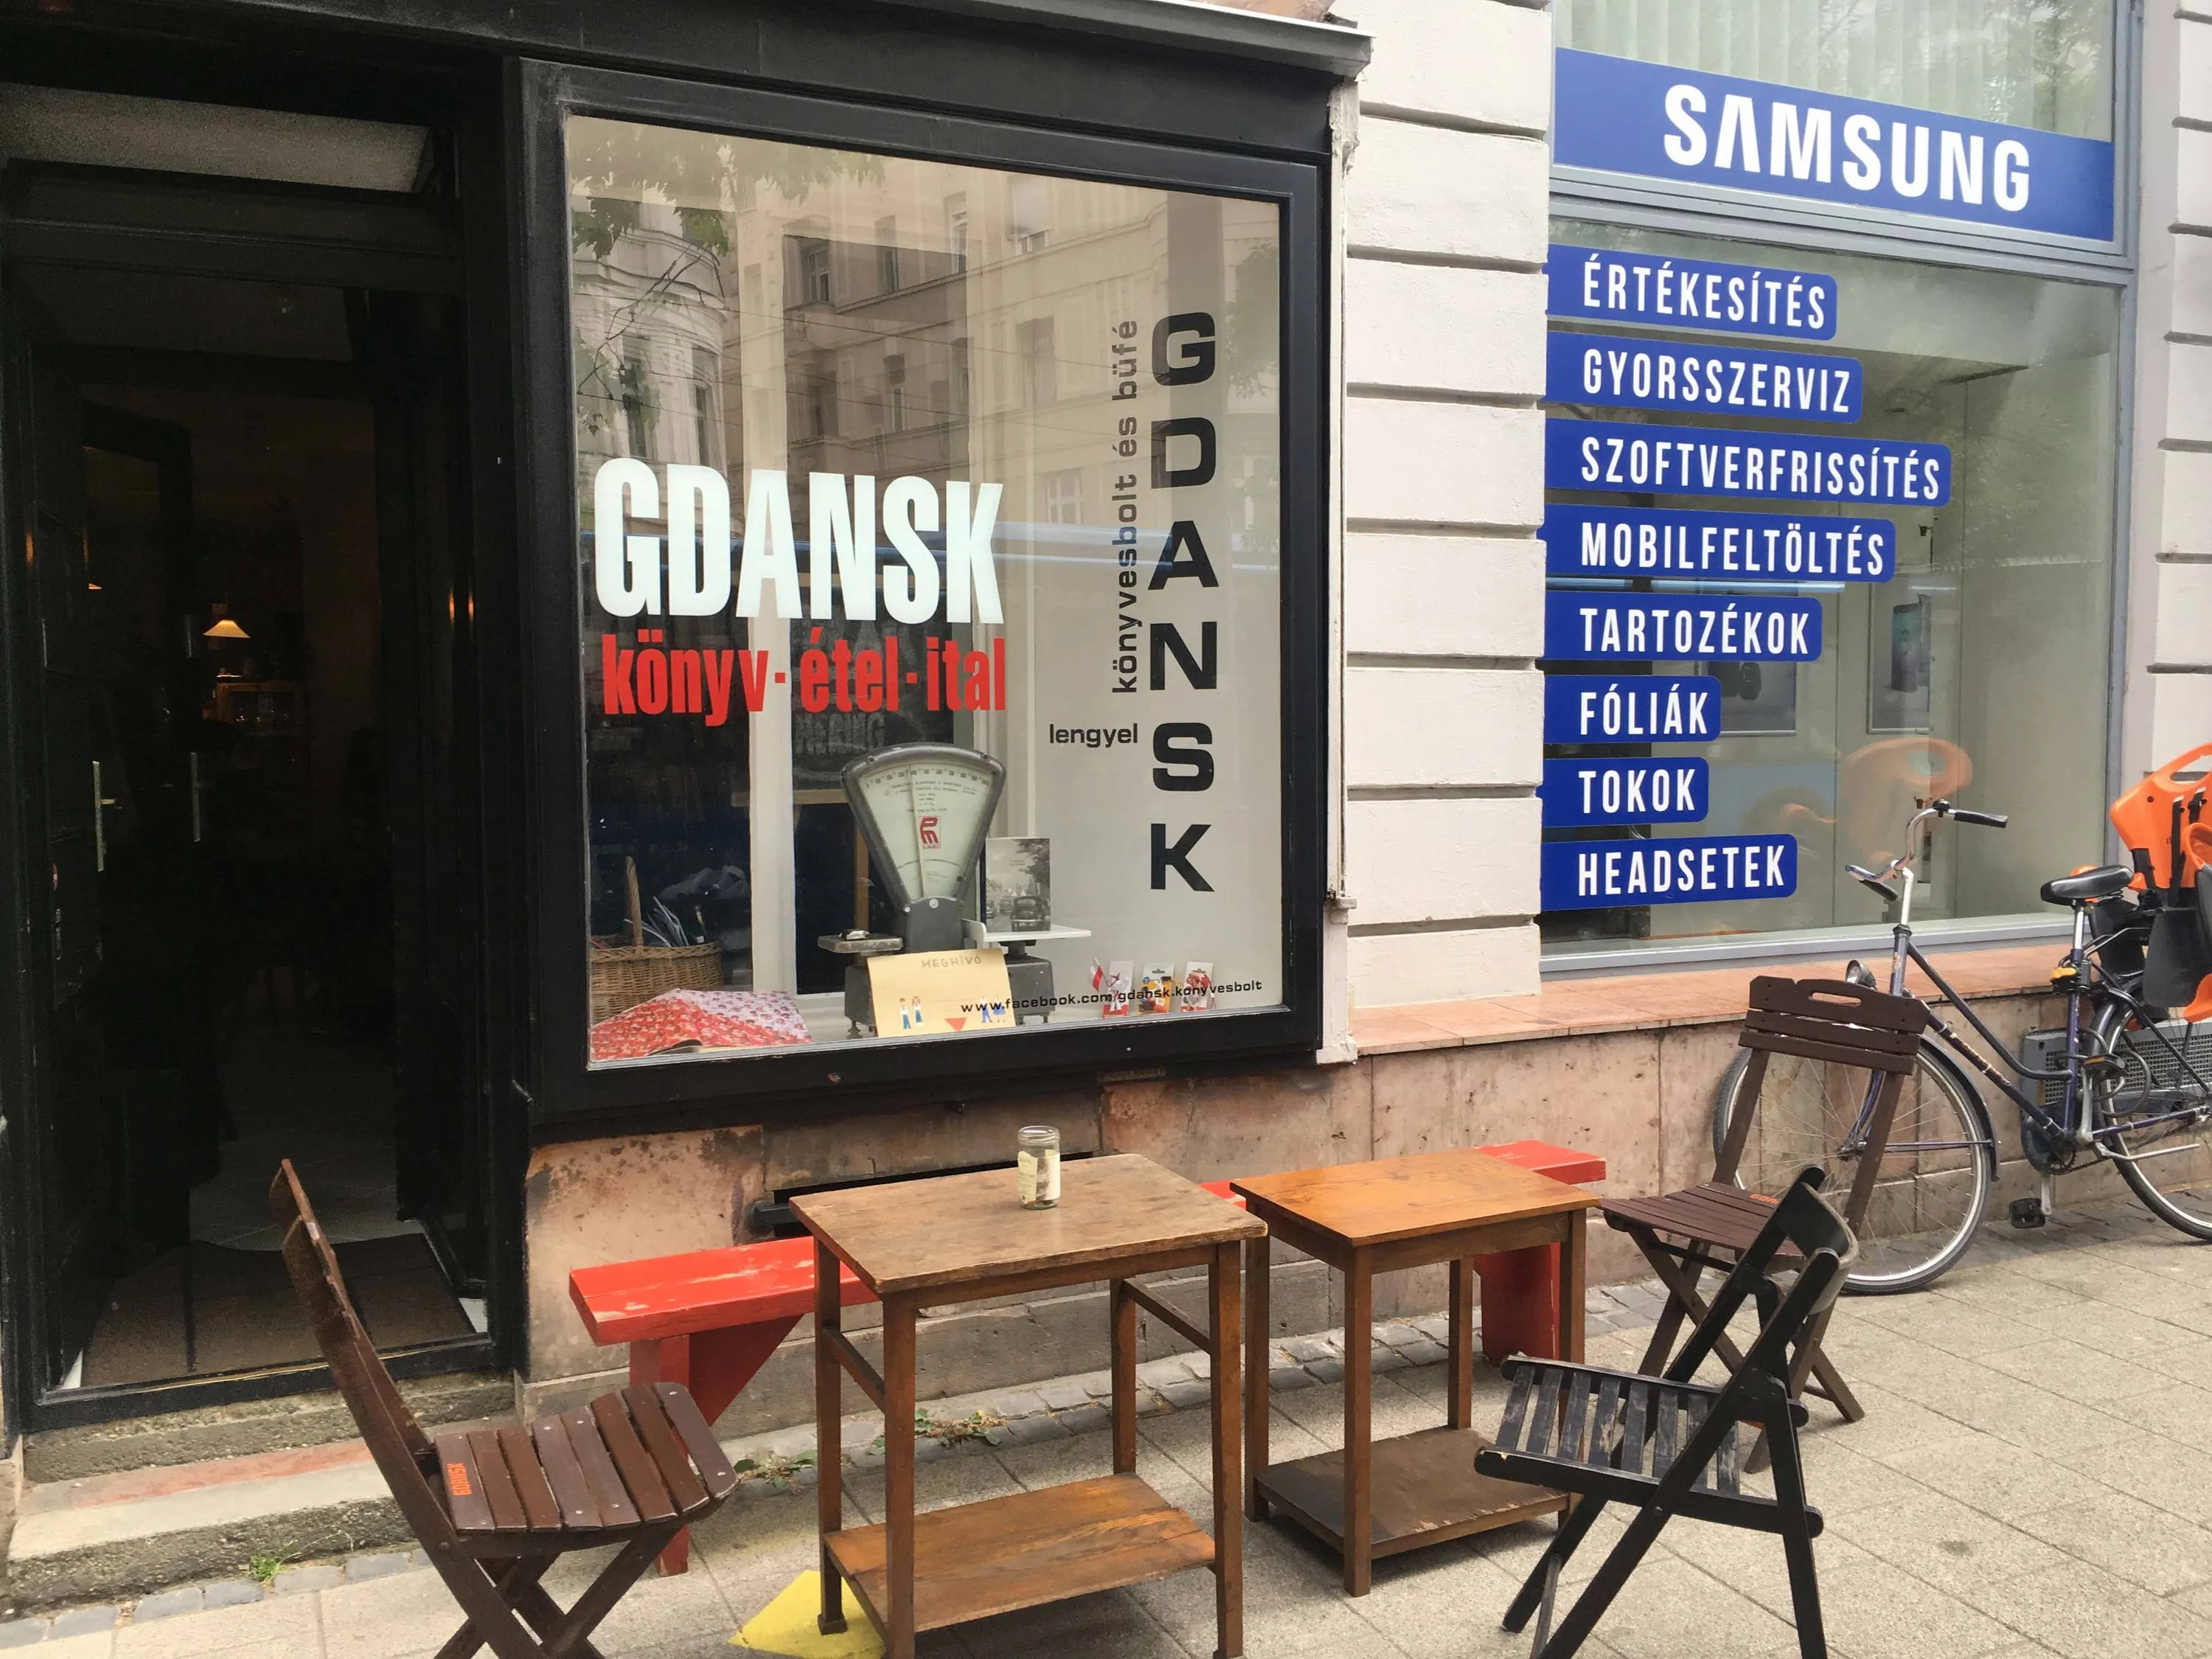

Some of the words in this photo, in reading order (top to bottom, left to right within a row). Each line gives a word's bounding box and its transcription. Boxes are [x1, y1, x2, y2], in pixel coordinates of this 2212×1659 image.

[1664, 84, 2031, 212] SAMSUNG
[1583, 253, 1826, 330] ÉRTÉKESÍTÉS
[1111, 319, 1138, 402] büfé
[1582, 347, 1851, 414] GYORSSZERVIZ
[1112, 415, 1138, 458] és
[1581, 436, 1940, 501] SZOFTVERFRISSÍTÉS
[594, 457, 1004, 625] GDANSK
[1581, 521, 1885, 576] MOBILFELTÖLTÉS
[1112, 472, 1139, 694] könyvesbolt
[1147, 311, 1220, 894] GDANSK
[1579, 602, 1809, 655] TARTOZÉKOK
[1048, 723, 1138, 748] lengyel
[1579, 683, 1708, 736] FÓLIÁK
[1578, 768, 1696, 815] TOKOK
[1578, 844, 1786, 897] HEADSETEK
